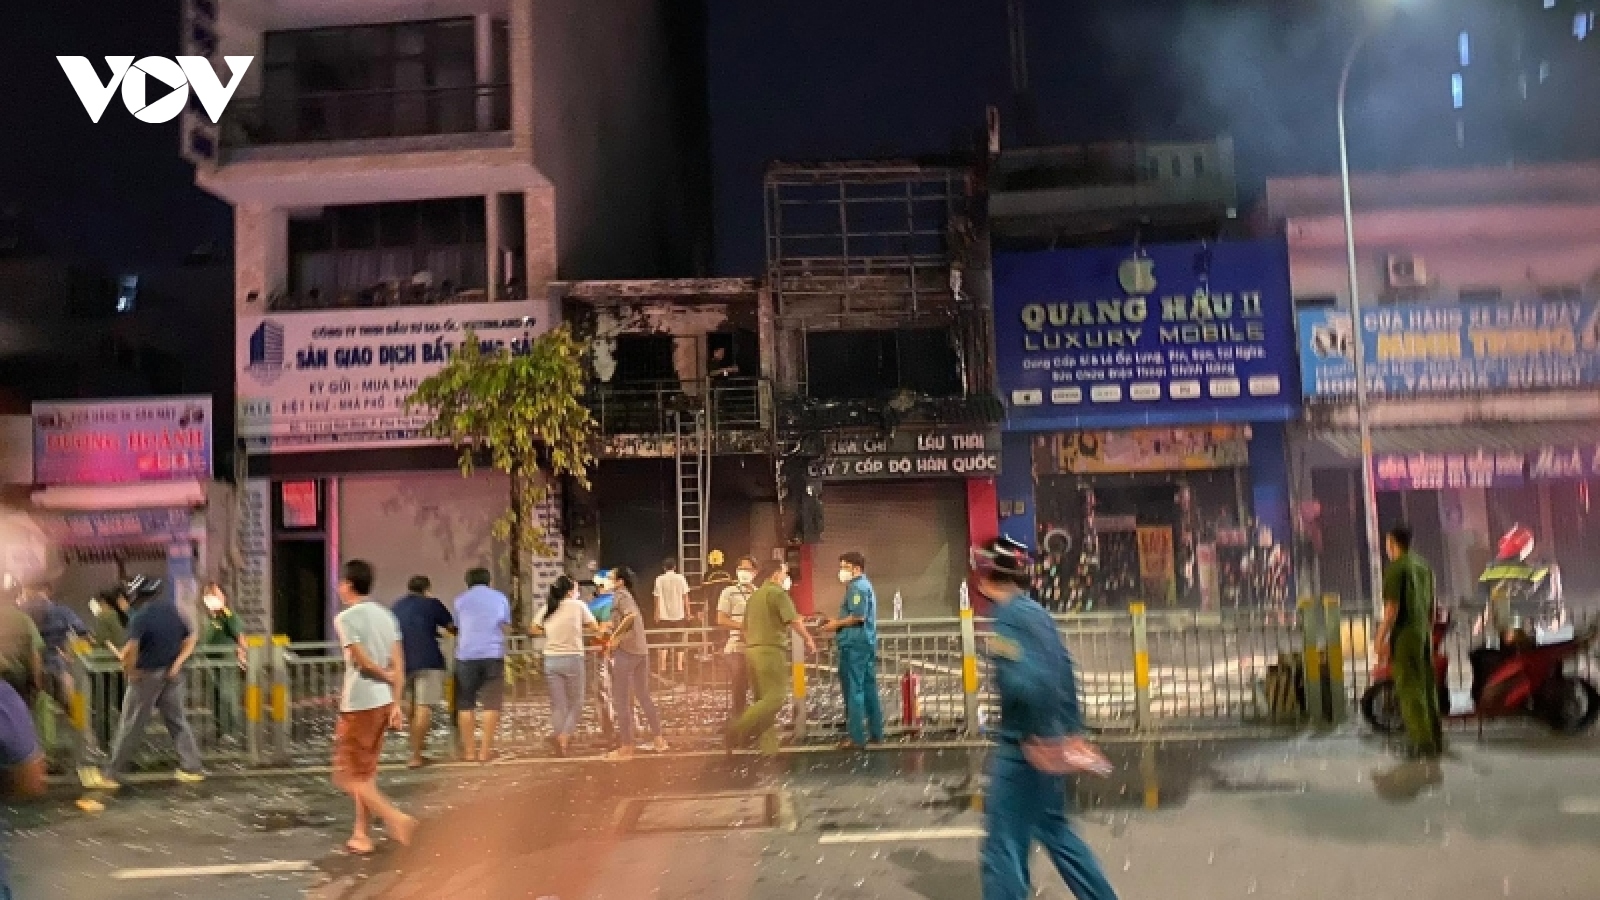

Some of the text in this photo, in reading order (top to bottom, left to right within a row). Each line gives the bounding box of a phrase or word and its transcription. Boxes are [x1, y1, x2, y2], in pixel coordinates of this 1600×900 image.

[1021, 298, 1148, 332] QUANG
[1024, 322, 1264, 350] LUXURY MOBILE
[296, 341, 329, 370] SÀN
[333, 346, 373, 369] GIAO
[379, 342, 416, 373] DỊCH
[361, 376, 391, 392] MUA
[917, 455, 948, 473] HÀN
[952, 451, 998, 473] QUỐC
